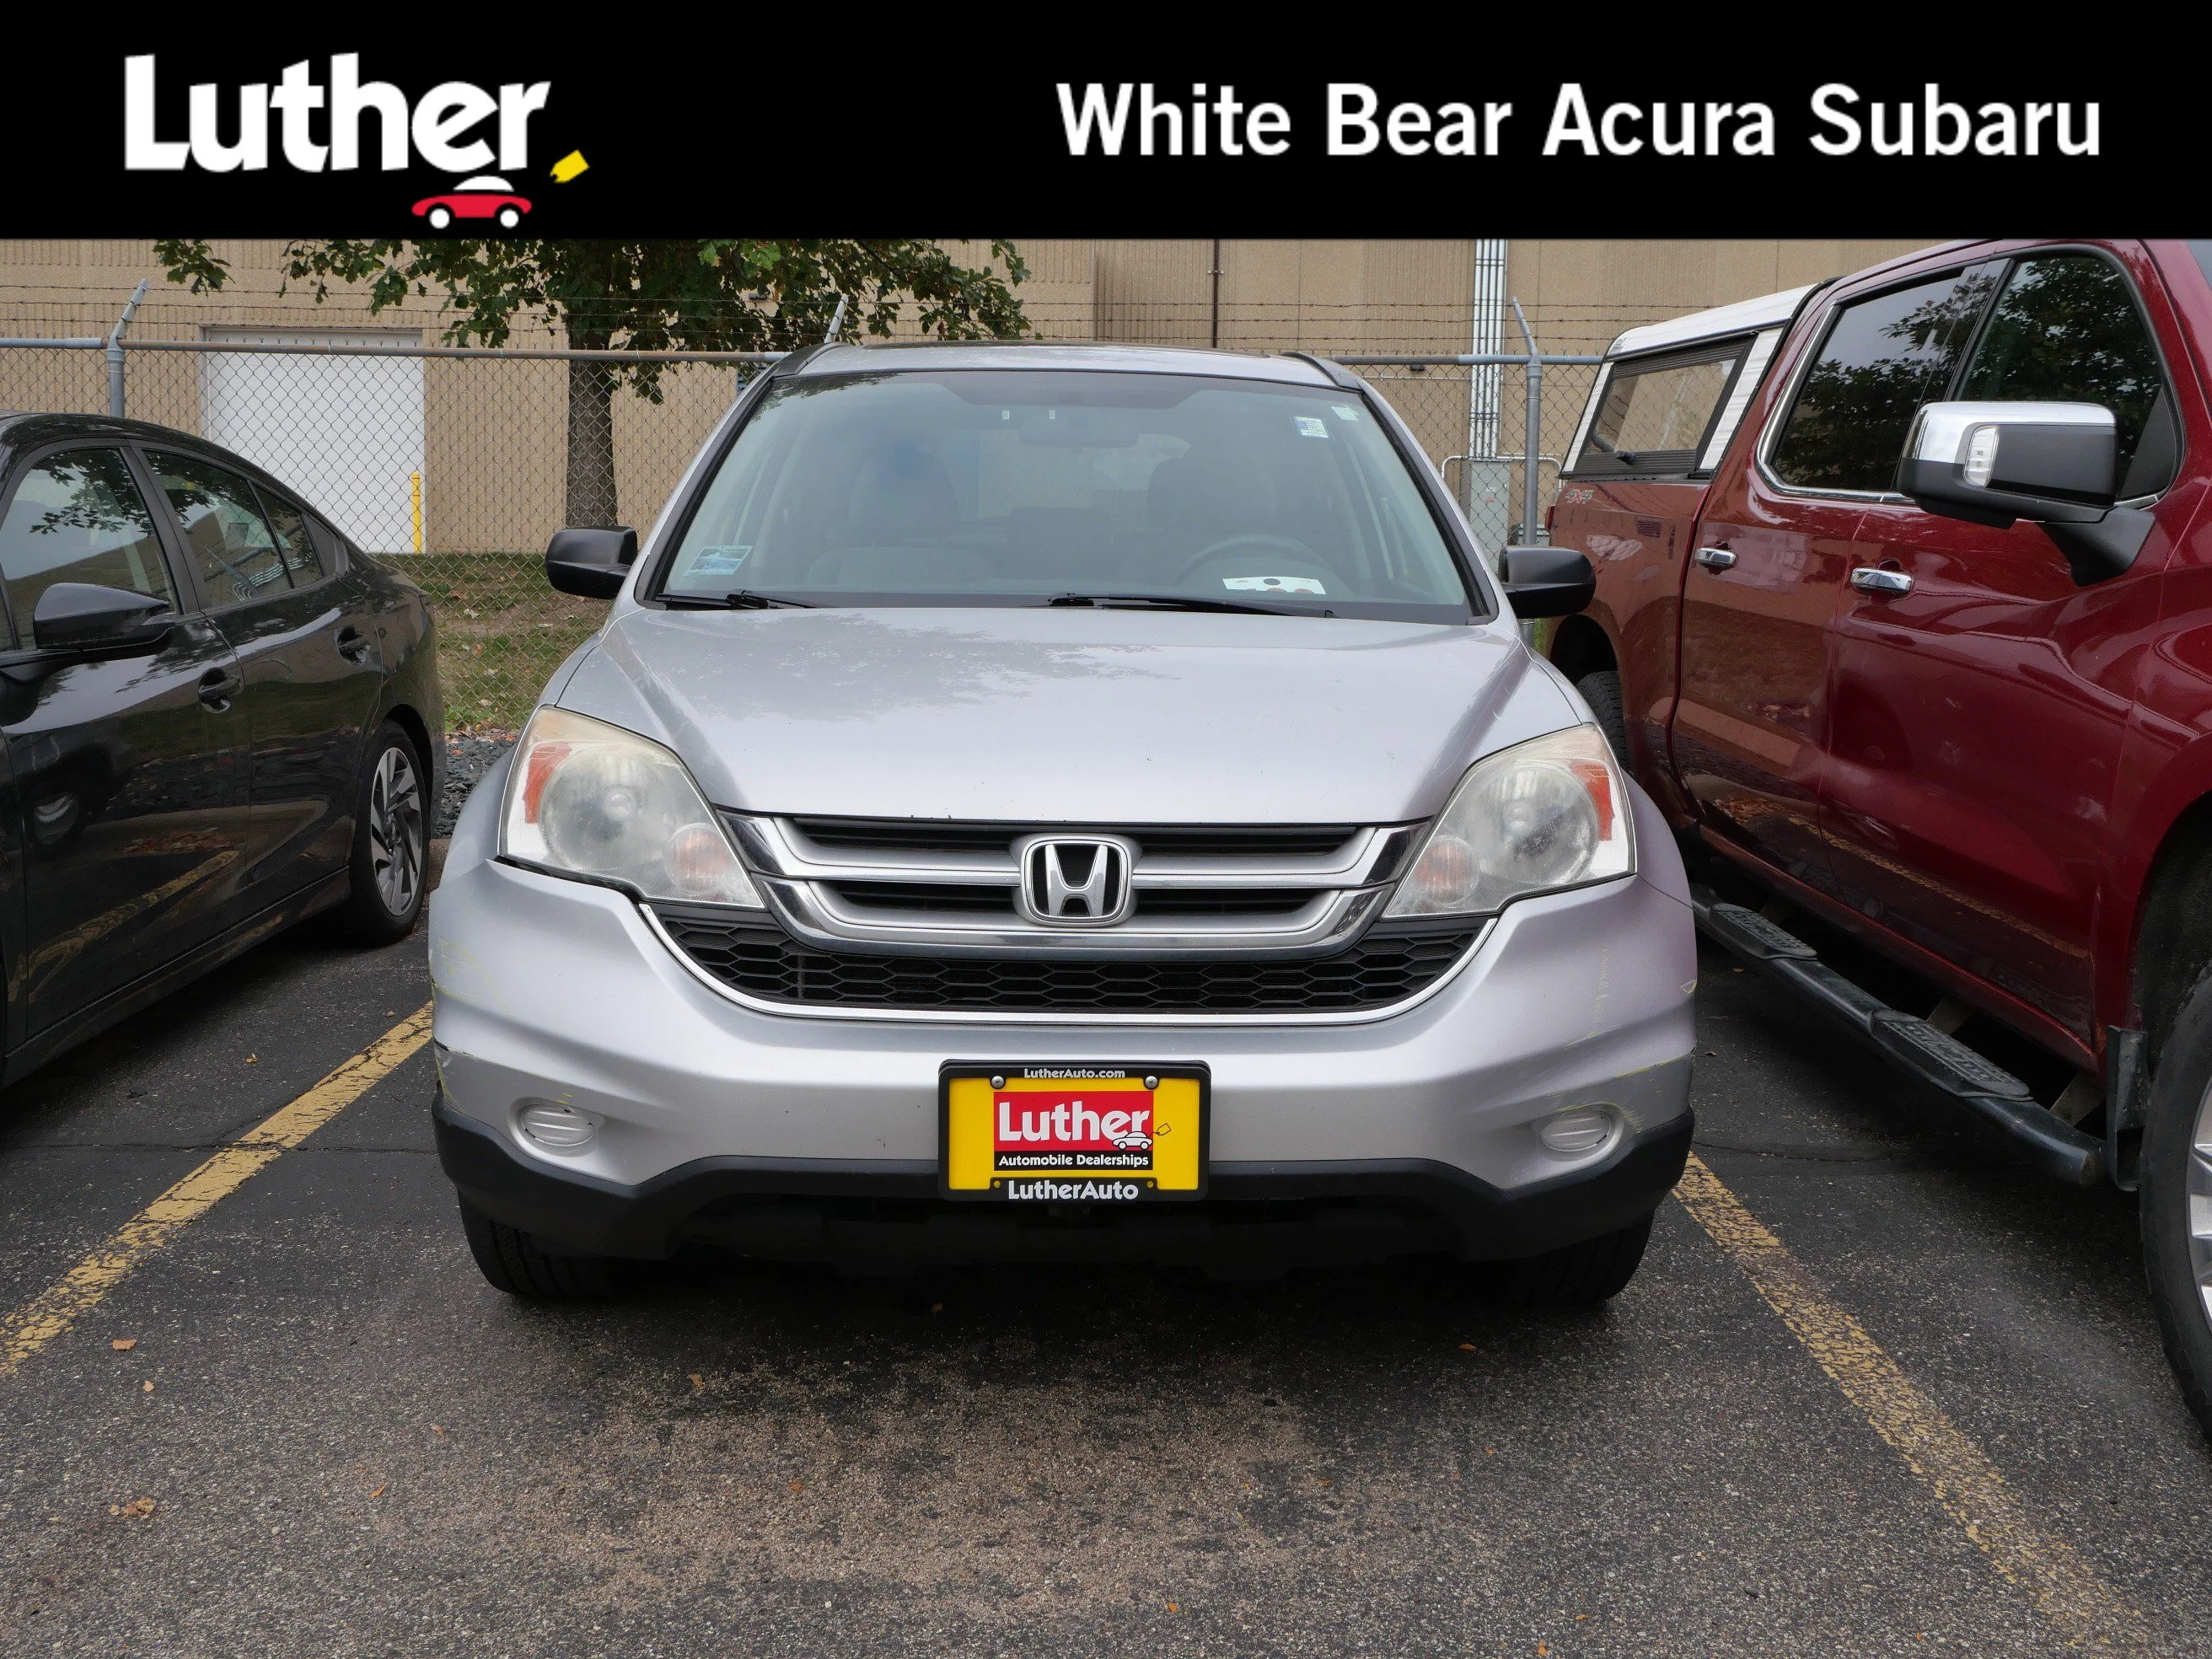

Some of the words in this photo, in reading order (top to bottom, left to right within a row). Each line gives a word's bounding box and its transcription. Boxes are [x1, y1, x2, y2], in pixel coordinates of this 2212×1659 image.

[1023, 1067, 1125, 1079] LutherAuto.com
[998, 1100, 1151, 1141] Luther
[998, 1153, 1073, 1167] Automobile
[1076, 1153, 1149, 1168] Dealerships
[1008, 1179, 1139, 1200] LutherAuto
